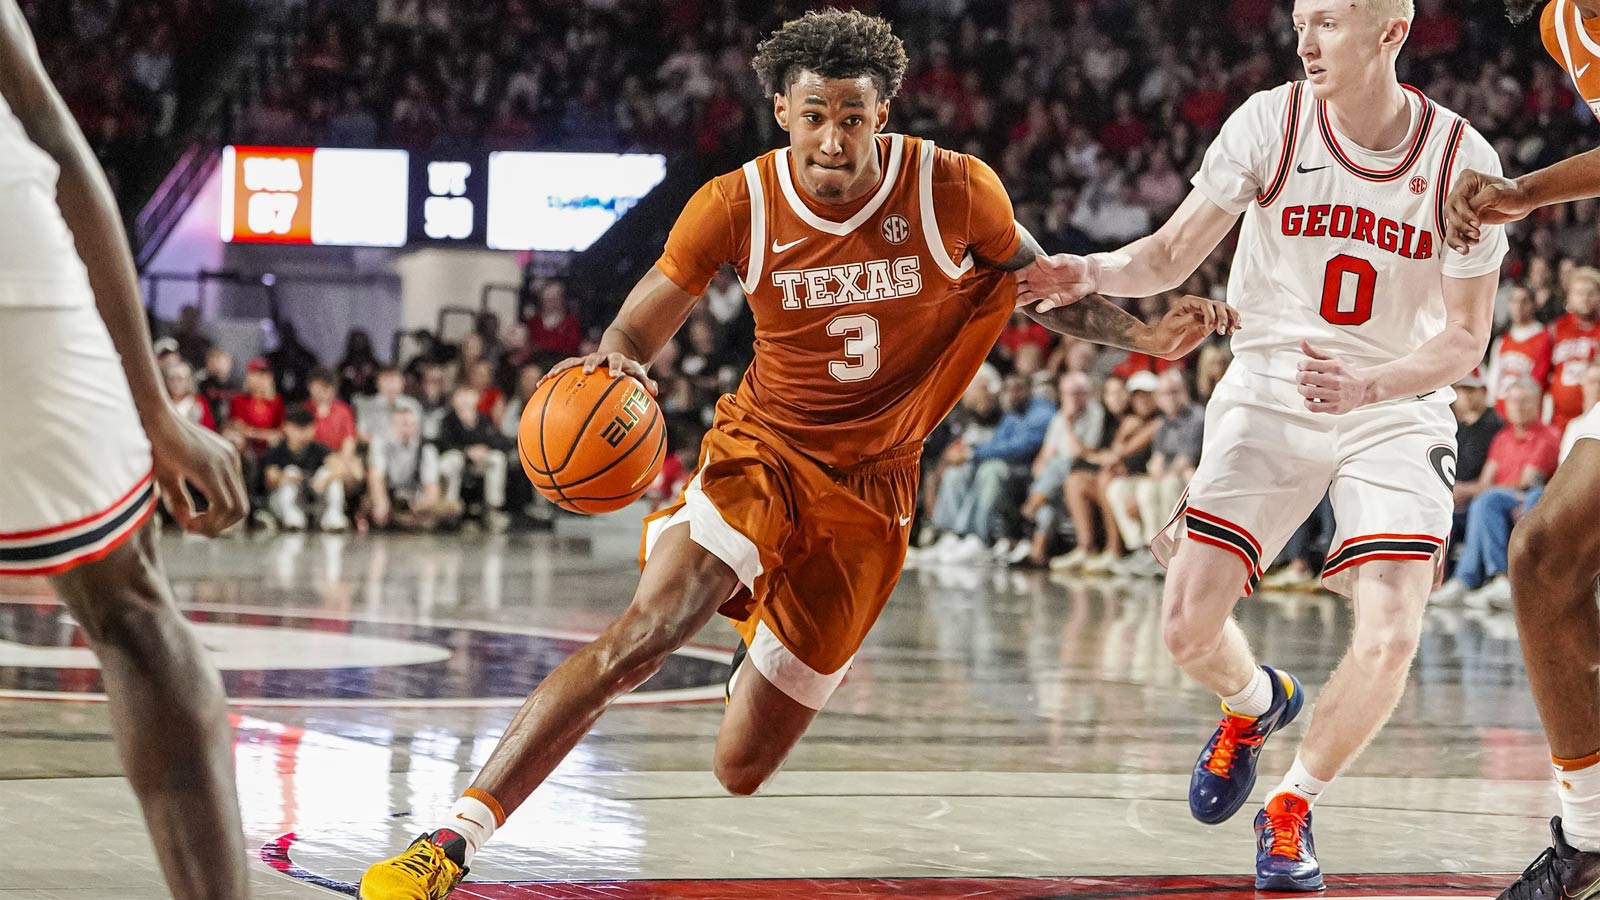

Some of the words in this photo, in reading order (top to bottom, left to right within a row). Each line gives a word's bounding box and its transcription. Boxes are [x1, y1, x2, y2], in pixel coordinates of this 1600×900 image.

[1410, 177, 1426, 194] SEC
[882, 215, 908, 243] SEC
[1281, 204, 1433, 260] GEORGIA
[772, 255, 922, 310] TEXAS
[1319, 253, 1377, 326] 0
[826, 313, 881, 383] 3
[600, 386, 651, 448] ELITE
